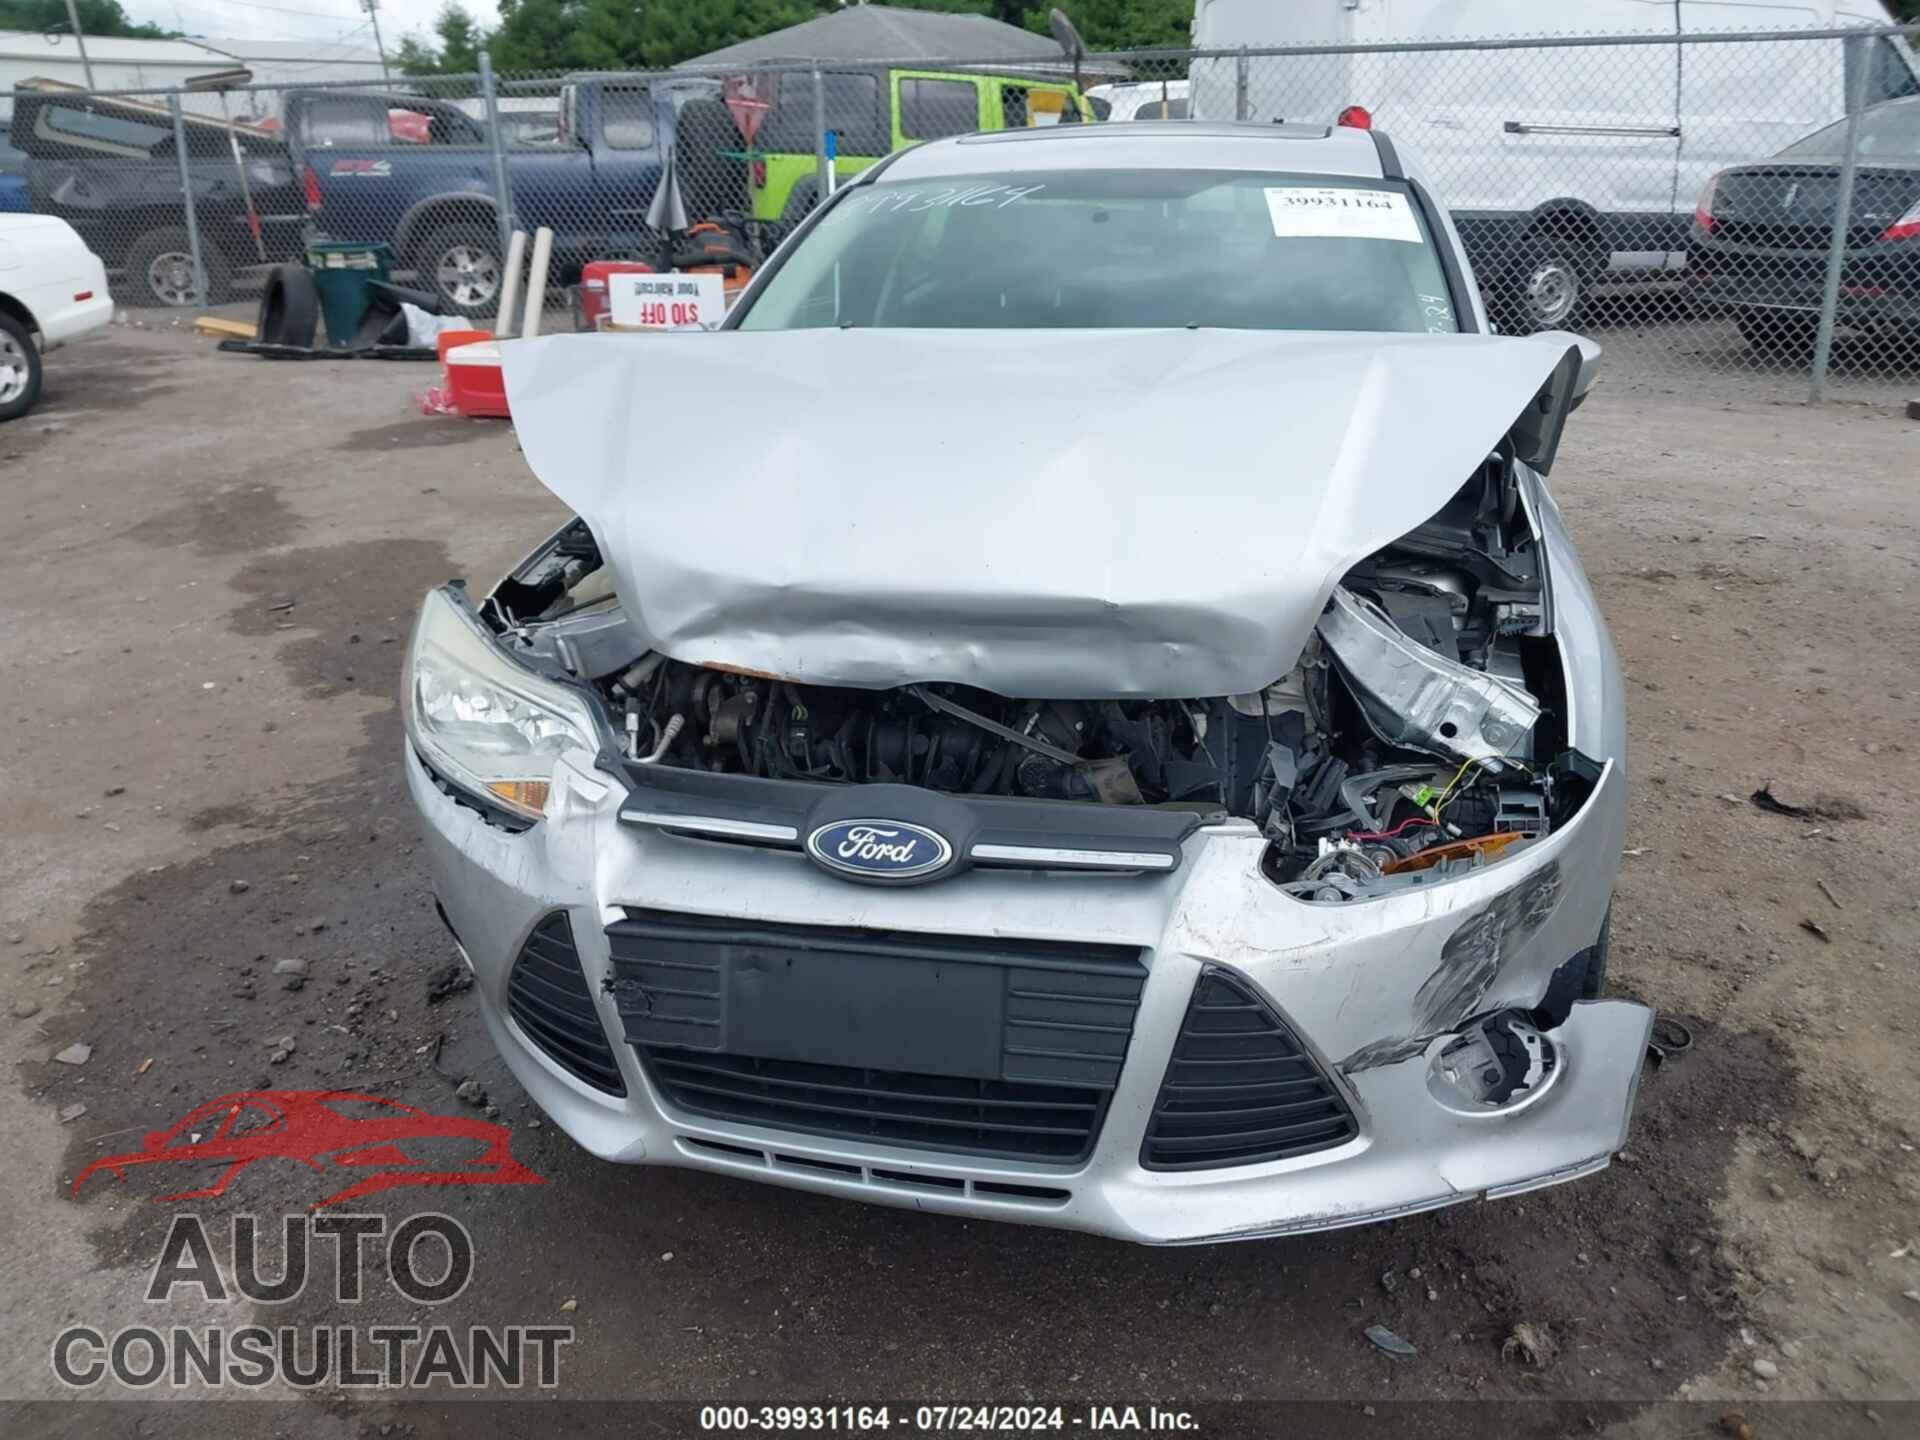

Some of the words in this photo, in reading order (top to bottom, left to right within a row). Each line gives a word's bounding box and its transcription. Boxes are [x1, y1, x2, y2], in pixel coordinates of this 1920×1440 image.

[1283, 196, 1393, 210] 39931164
[677, 283, 699, 297] Your
[640, 303, 666, 325] OFF
[671, 303, 699, 327] $10
[838, 826, 917, 863] Ford
